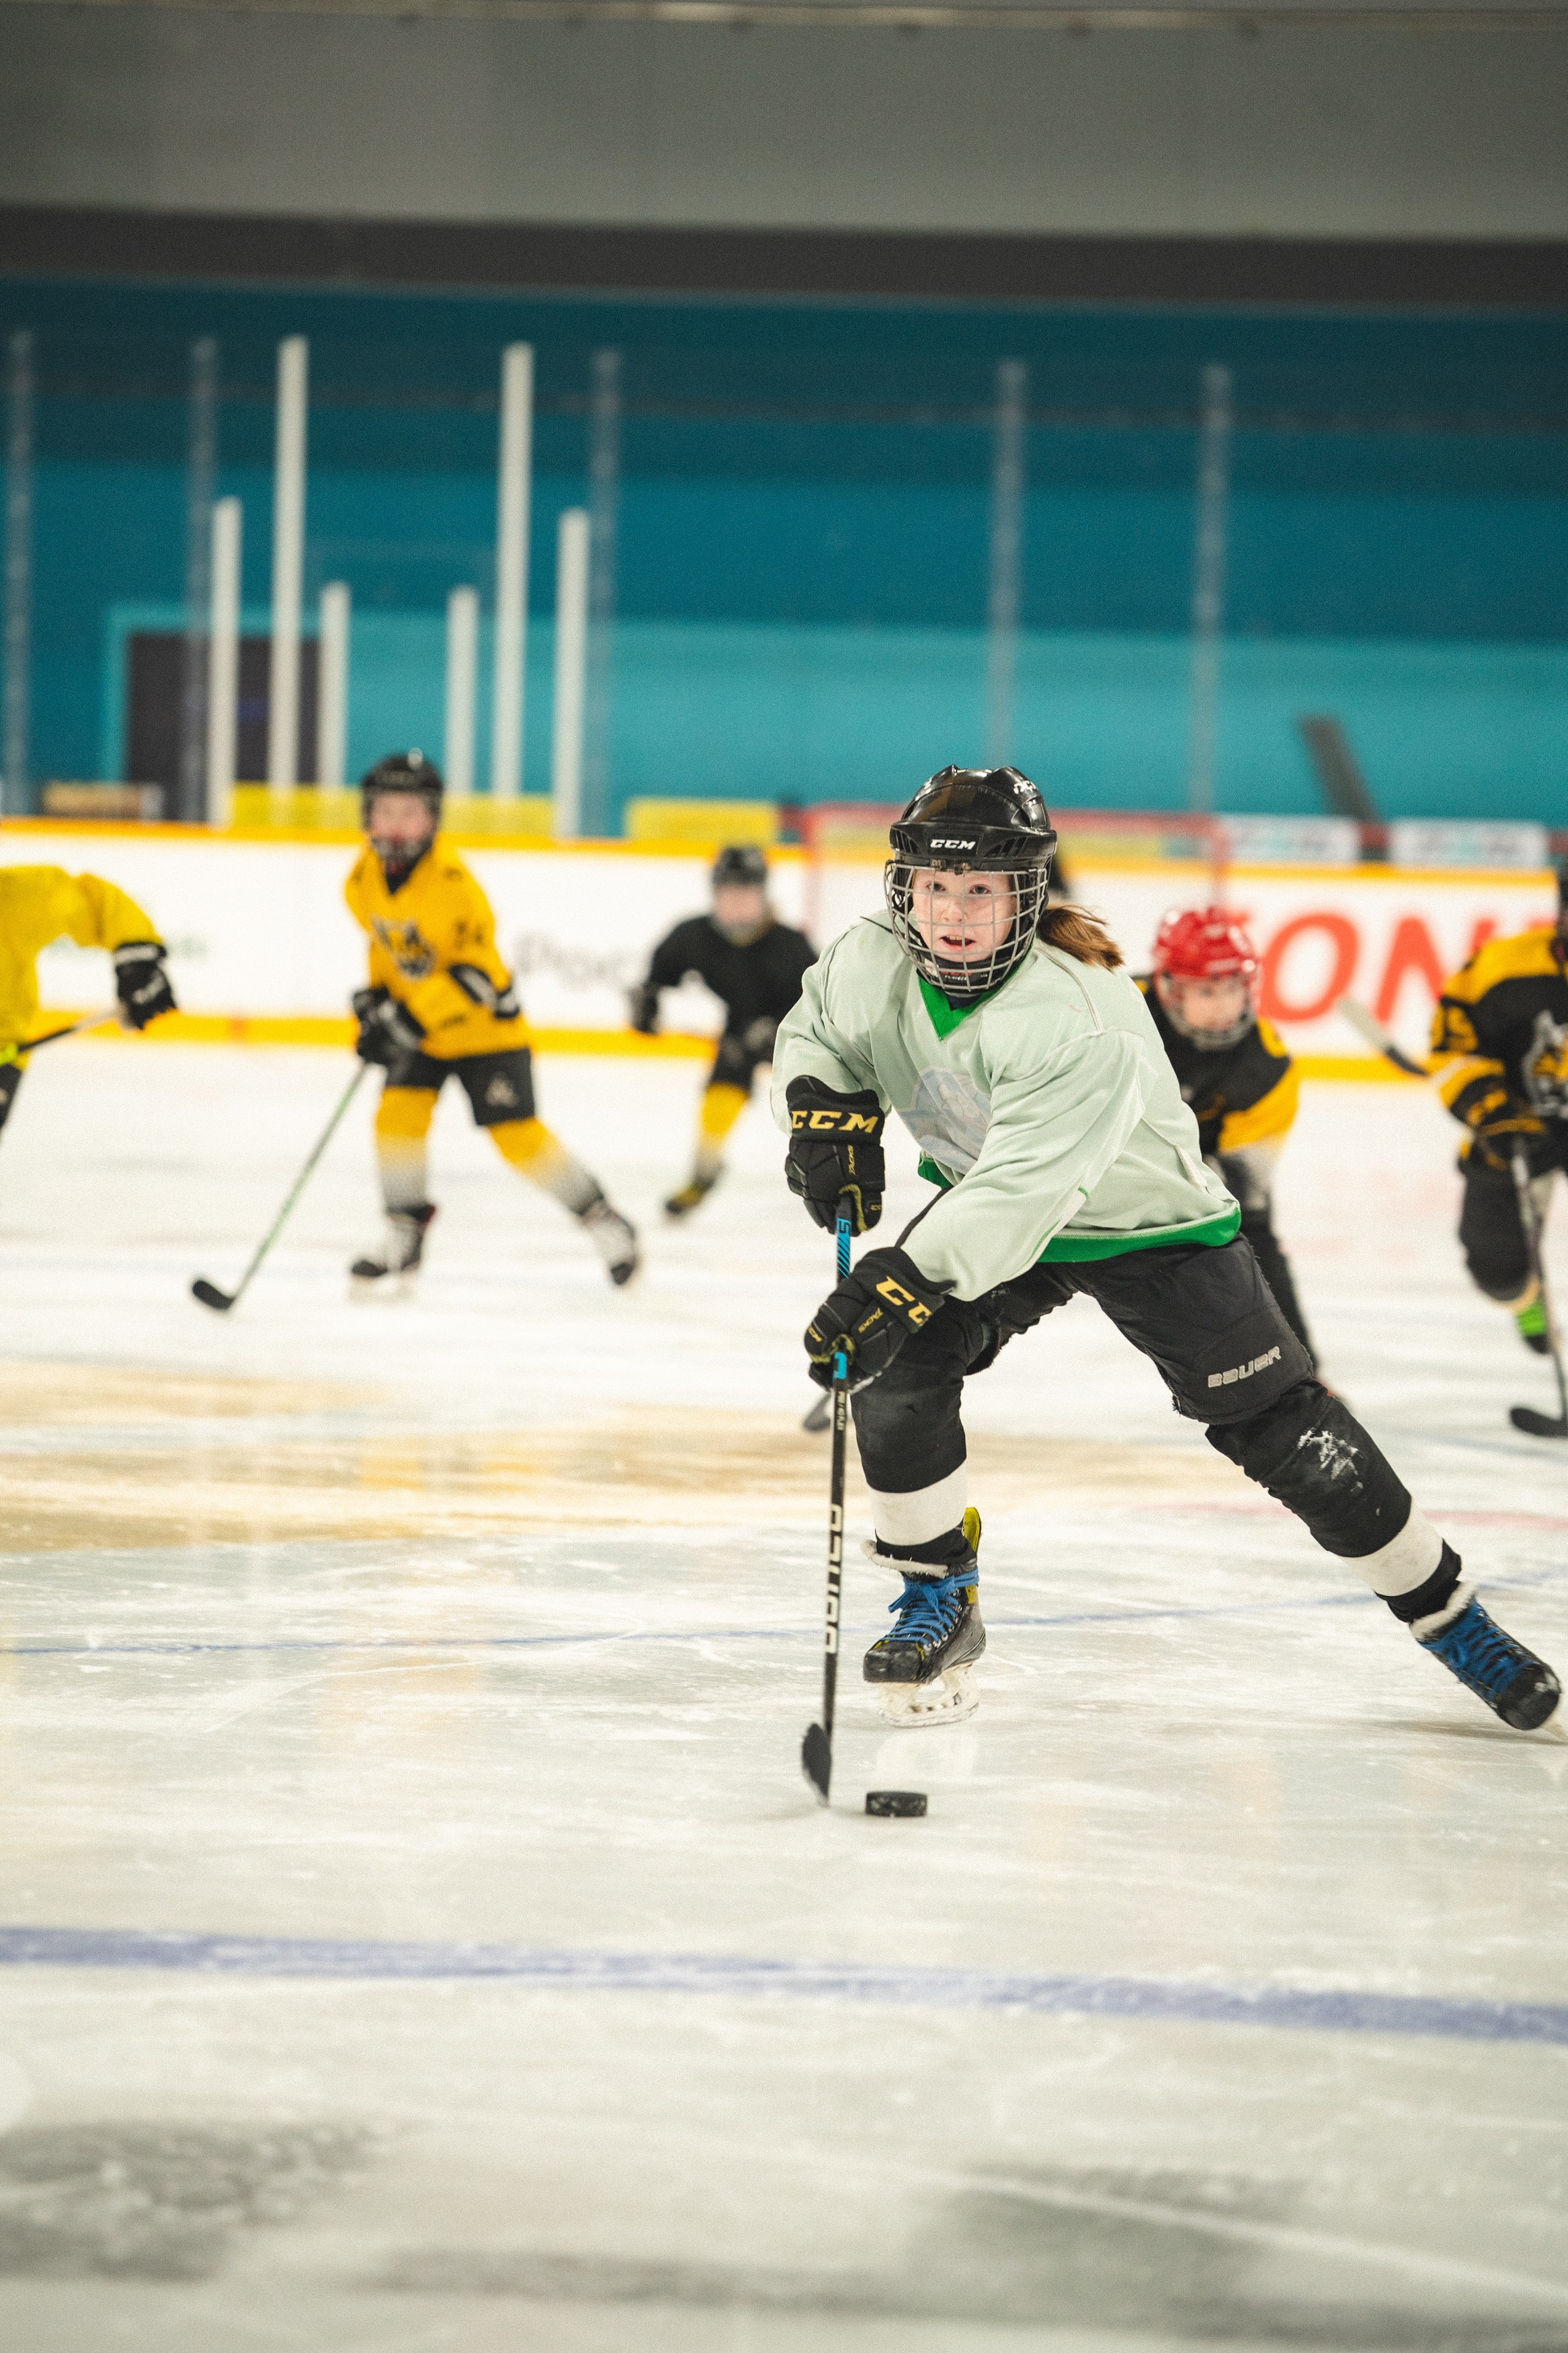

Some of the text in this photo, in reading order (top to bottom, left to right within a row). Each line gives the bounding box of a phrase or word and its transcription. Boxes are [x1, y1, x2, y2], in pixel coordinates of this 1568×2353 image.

[930, 839, 977, 850] CCM
[791, 1110, 878, 1133] CCM
[1208, 1346, 1282, 1388] BAUER
